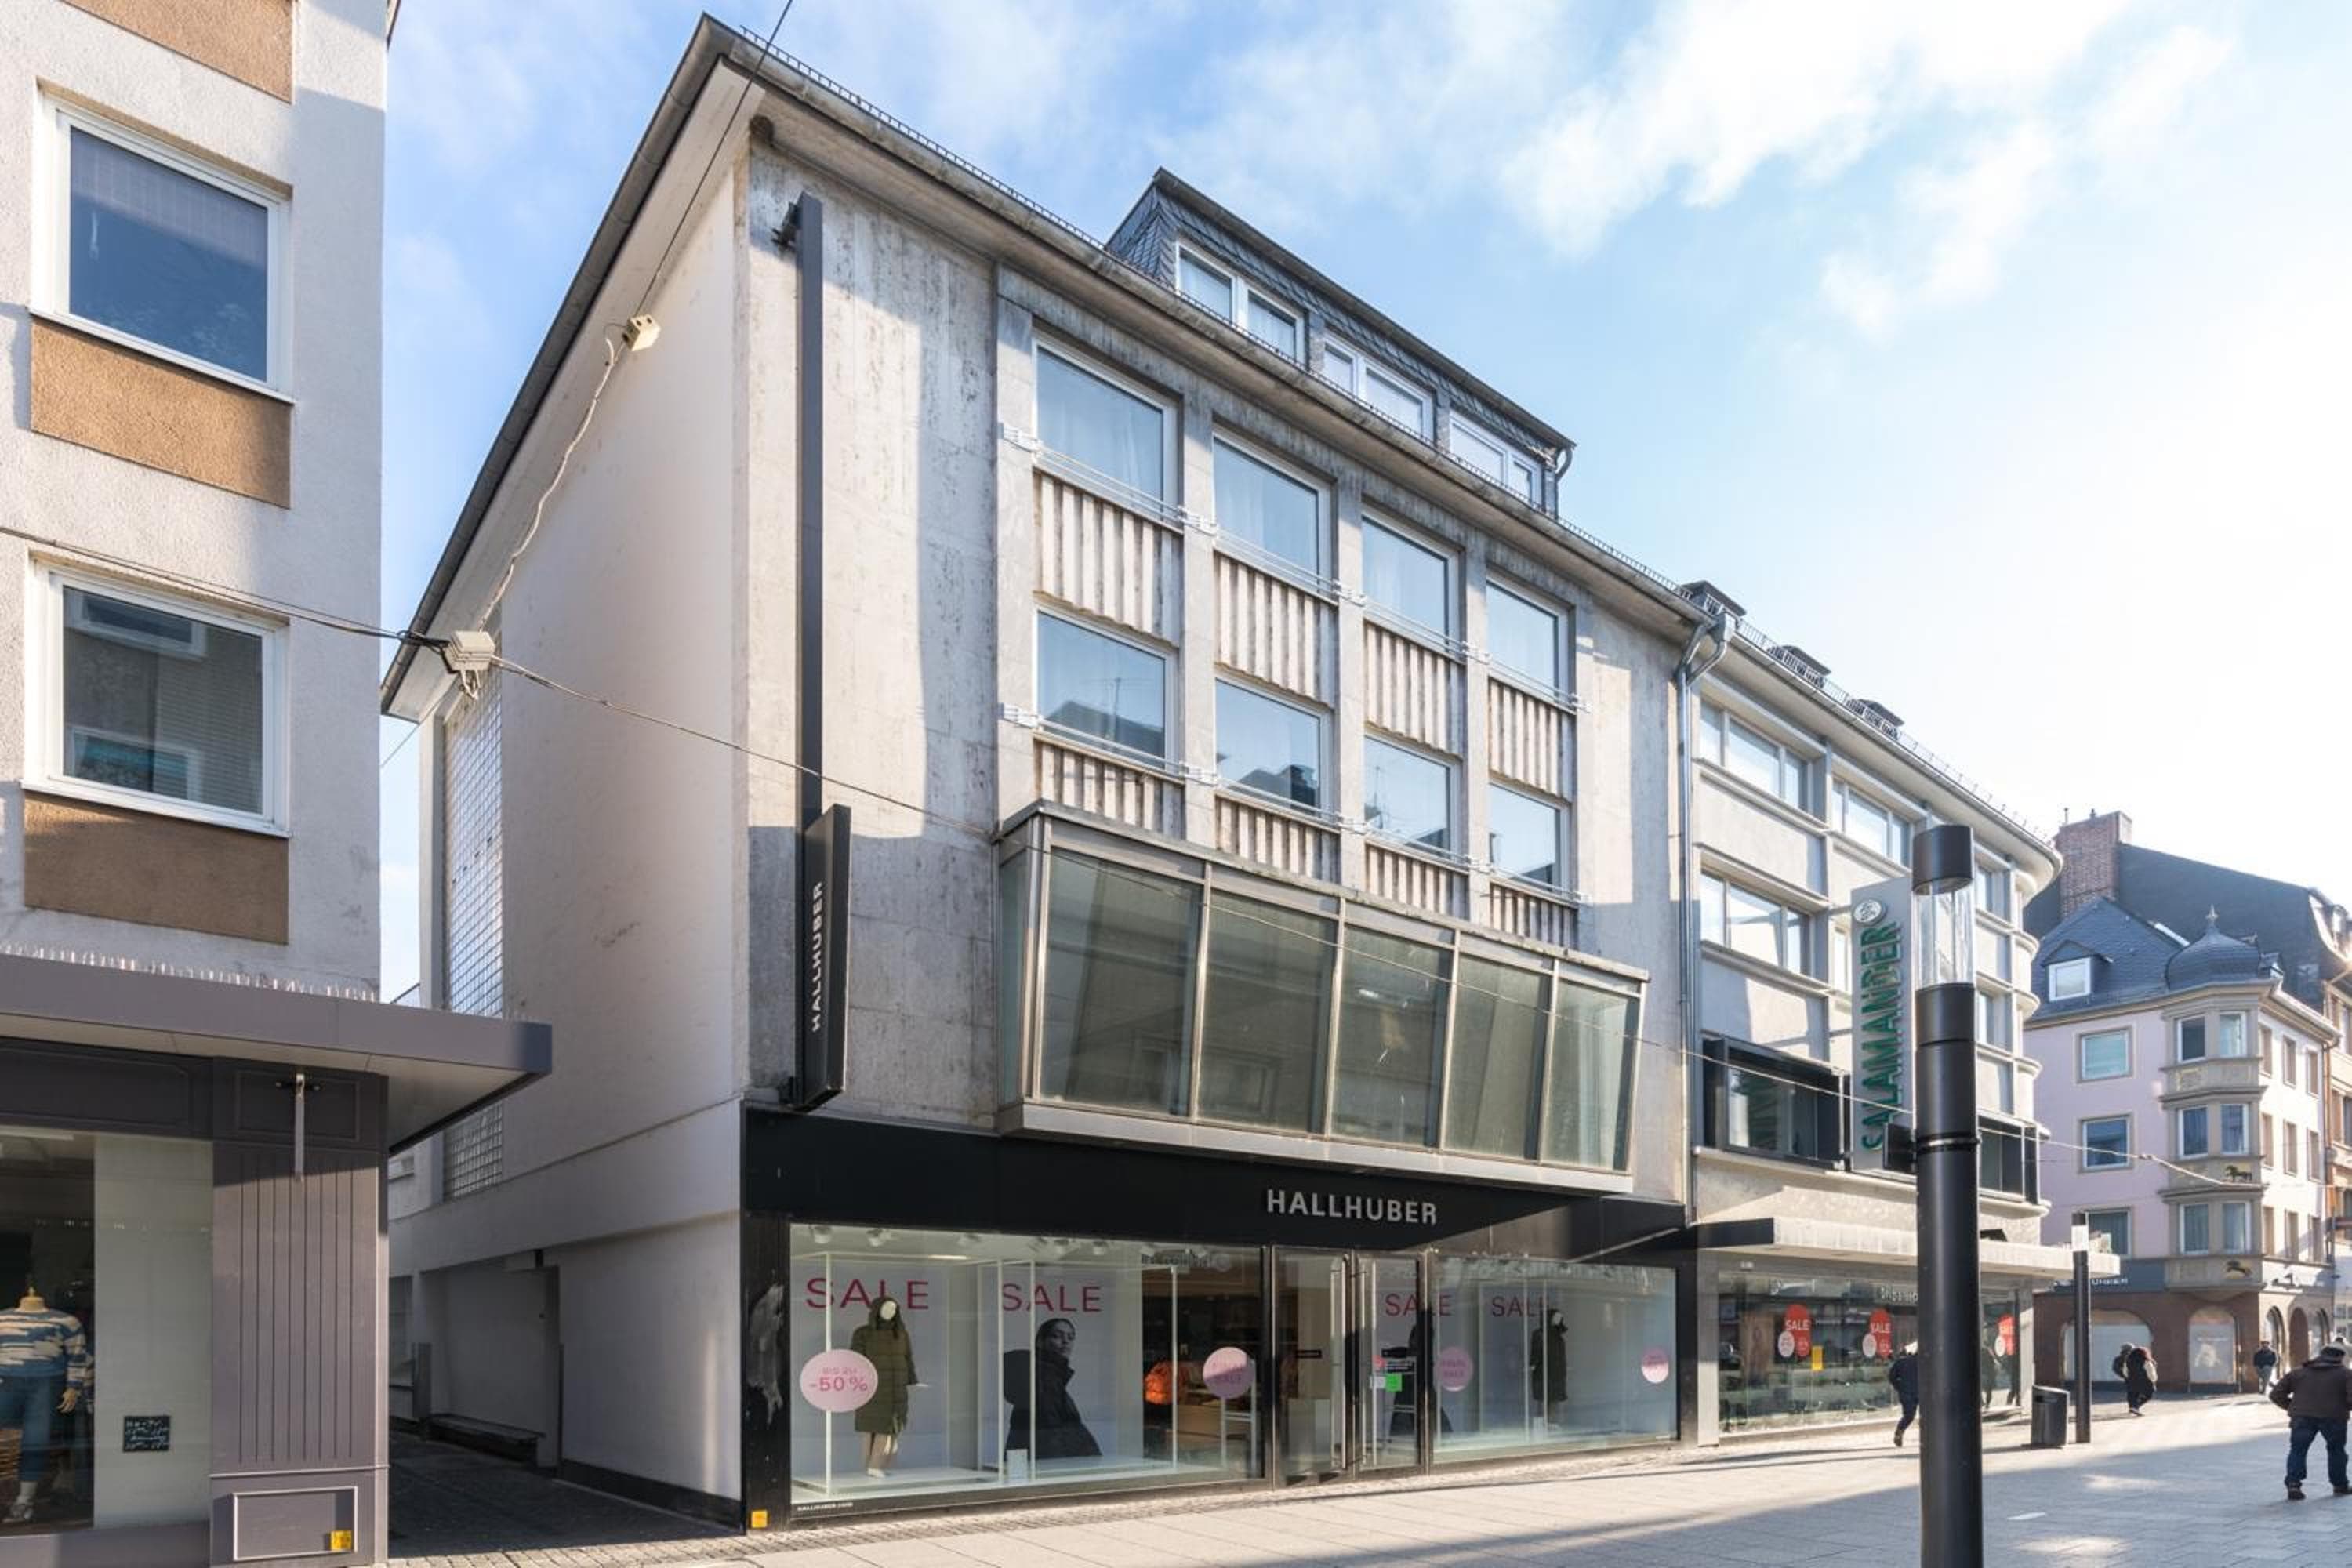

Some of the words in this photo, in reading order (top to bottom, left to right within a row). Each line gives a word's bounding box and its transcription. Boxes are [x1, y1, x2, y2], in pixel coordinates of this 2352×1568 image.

[812, 881, 822, 1033] HALLHUBER
[1861, 921, 1901, 1152] SALAMANDER
[1267, 1189, 1437, 1225] HALLHUBER
[1001, 1283, 1102, 1312] SALE
[1385, 1293, 1453, 1317] SAE
[1784, 1319, 1811, 1331] SALE
